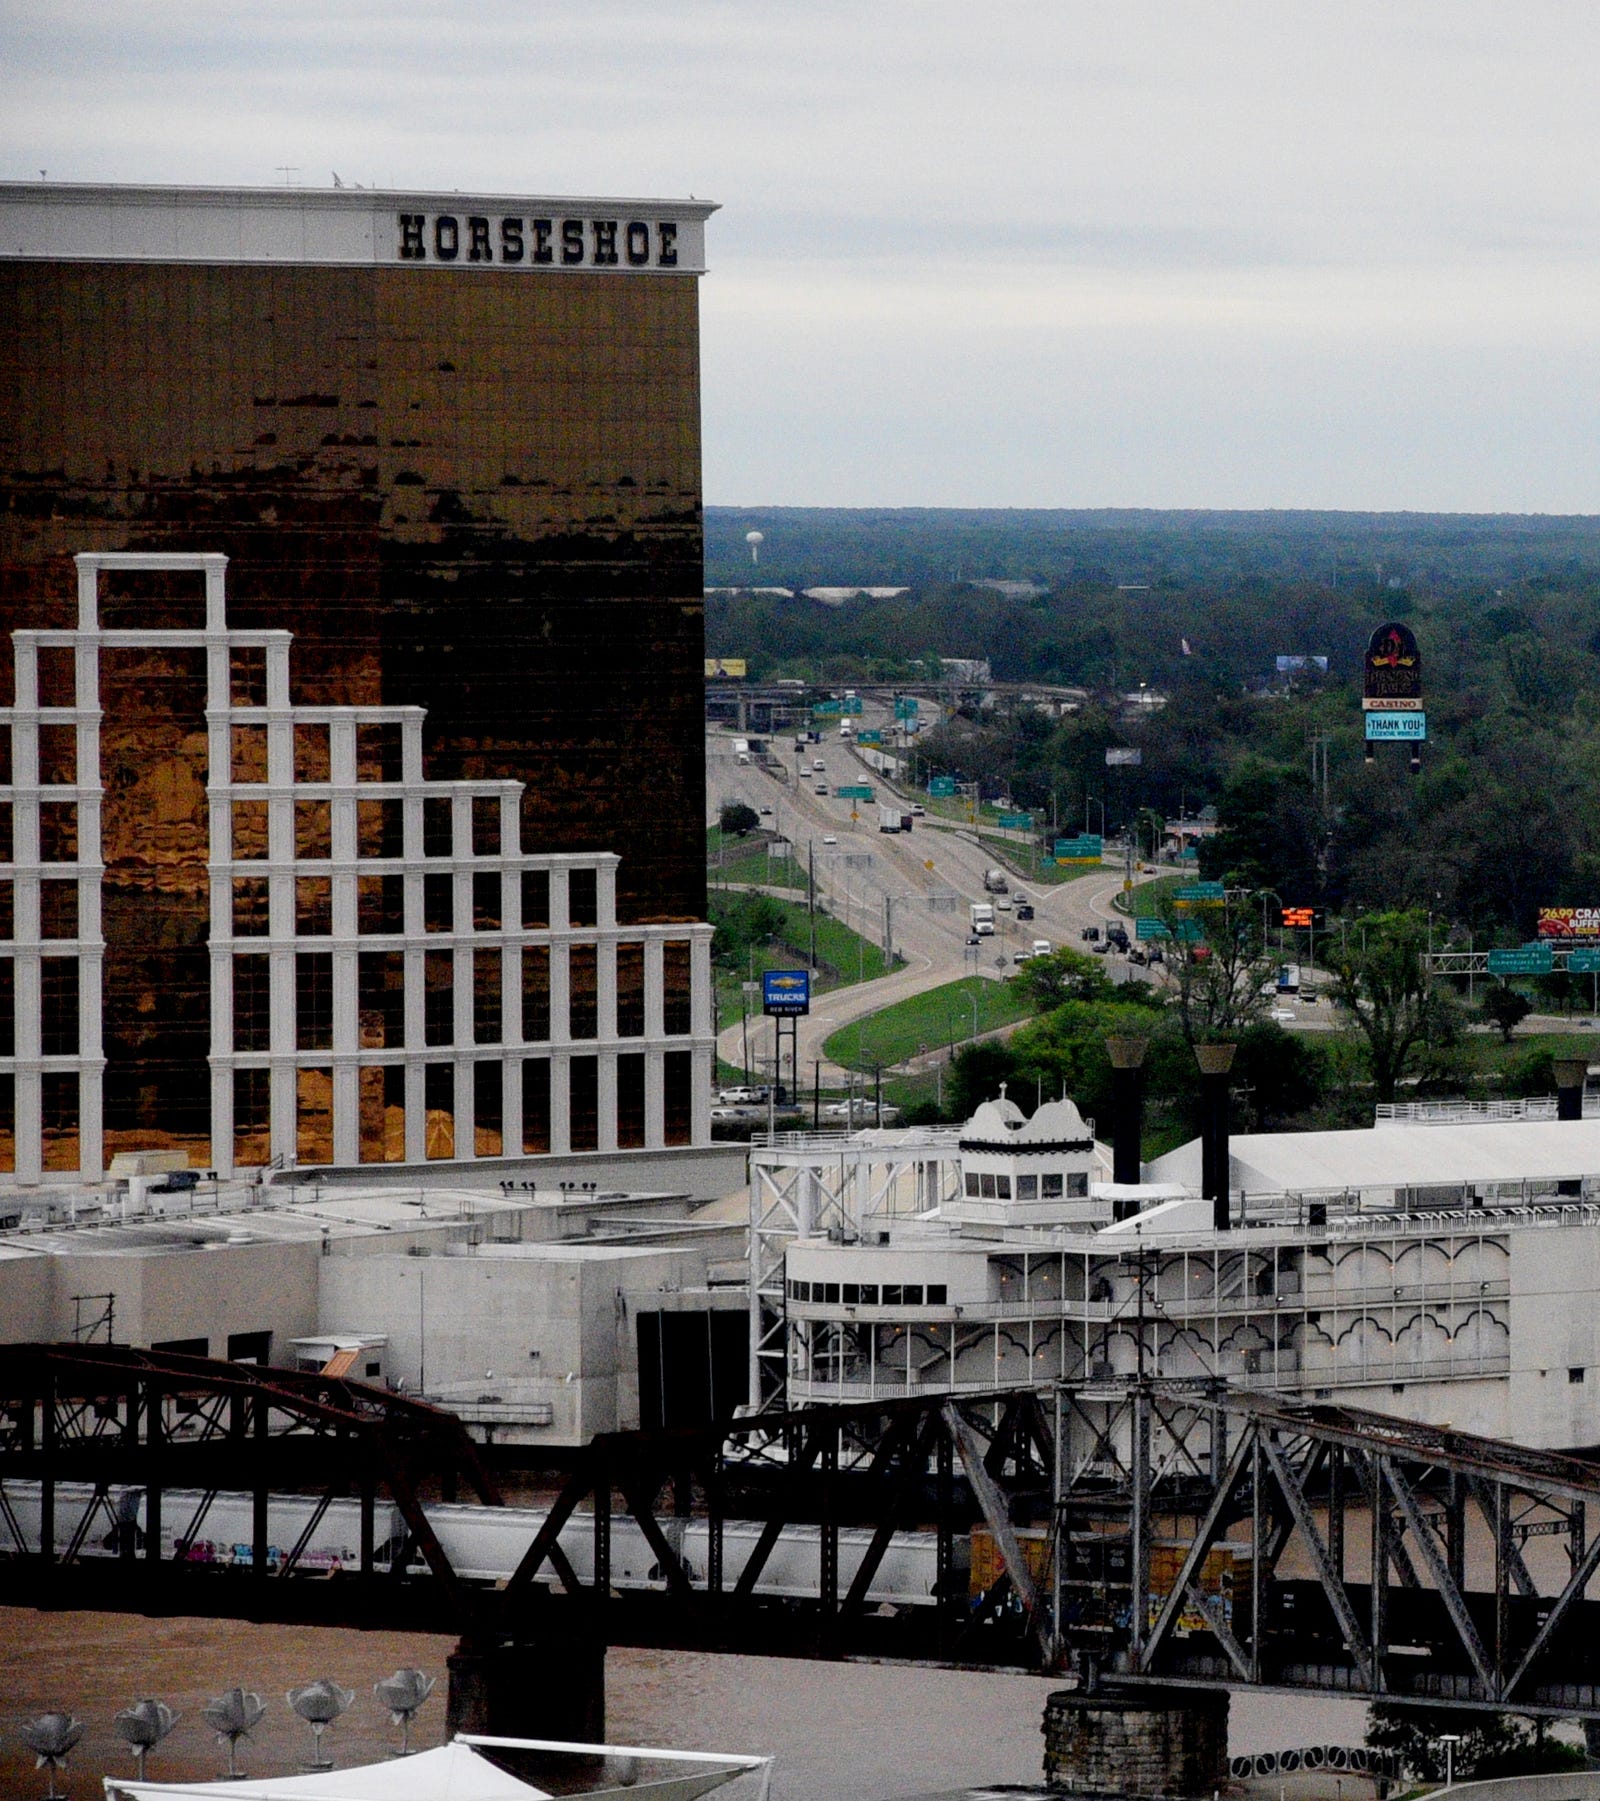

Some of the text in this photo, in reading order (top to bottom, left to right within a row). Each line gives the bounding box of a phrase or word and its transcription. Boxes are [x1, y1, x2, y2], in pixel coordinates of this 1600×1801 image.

[400, 214, 677, 266] HORSESHOE
[1371, 720, 1420, 730] THANK YOU
[768, 993, 806, 1001] TRUCKS
